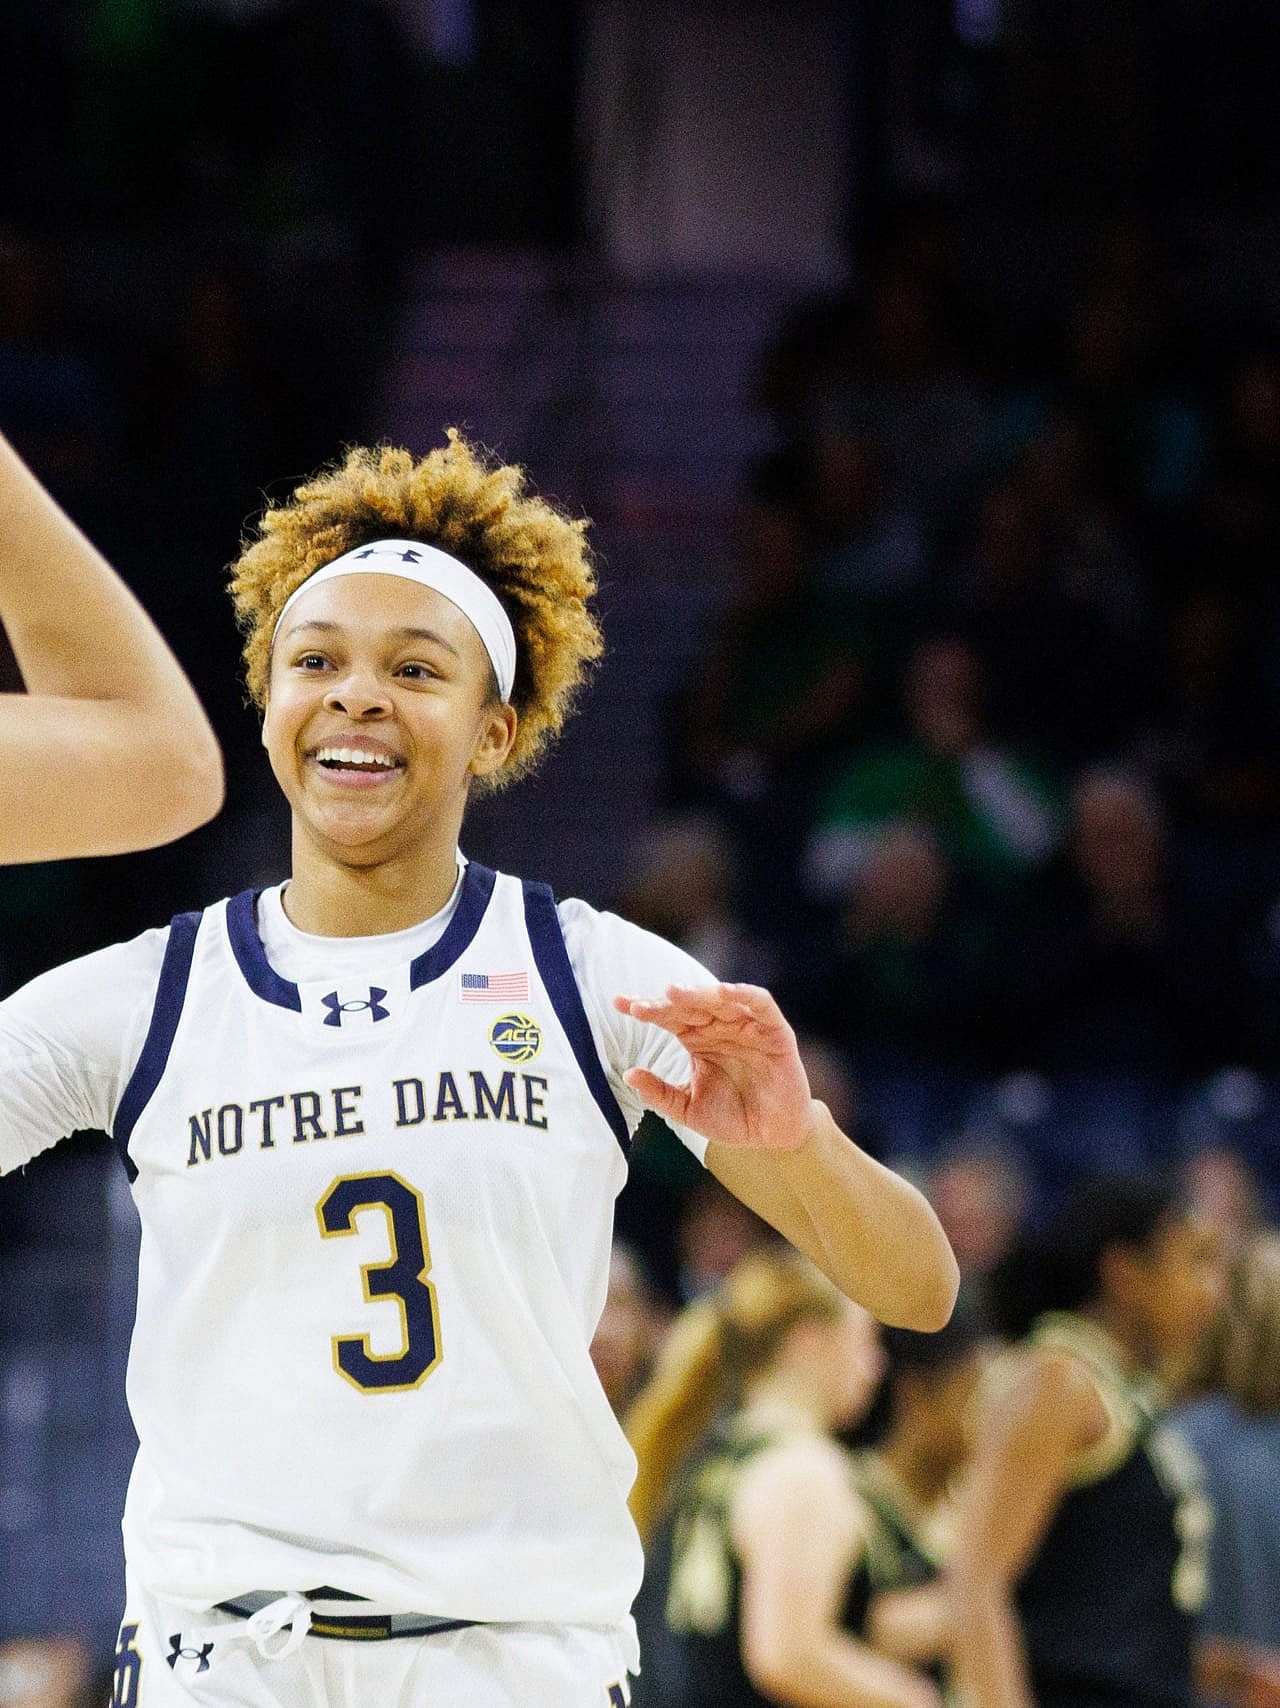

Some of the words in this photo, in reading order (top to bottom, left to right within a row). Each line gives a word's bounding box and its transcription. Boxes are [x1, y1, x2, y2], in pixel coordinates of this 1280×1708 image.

[185, 1084, 367, 1169] NOTRE
[391, 1069, 551, 1132] DAME
[314, 1168, 445, 1395] 3
